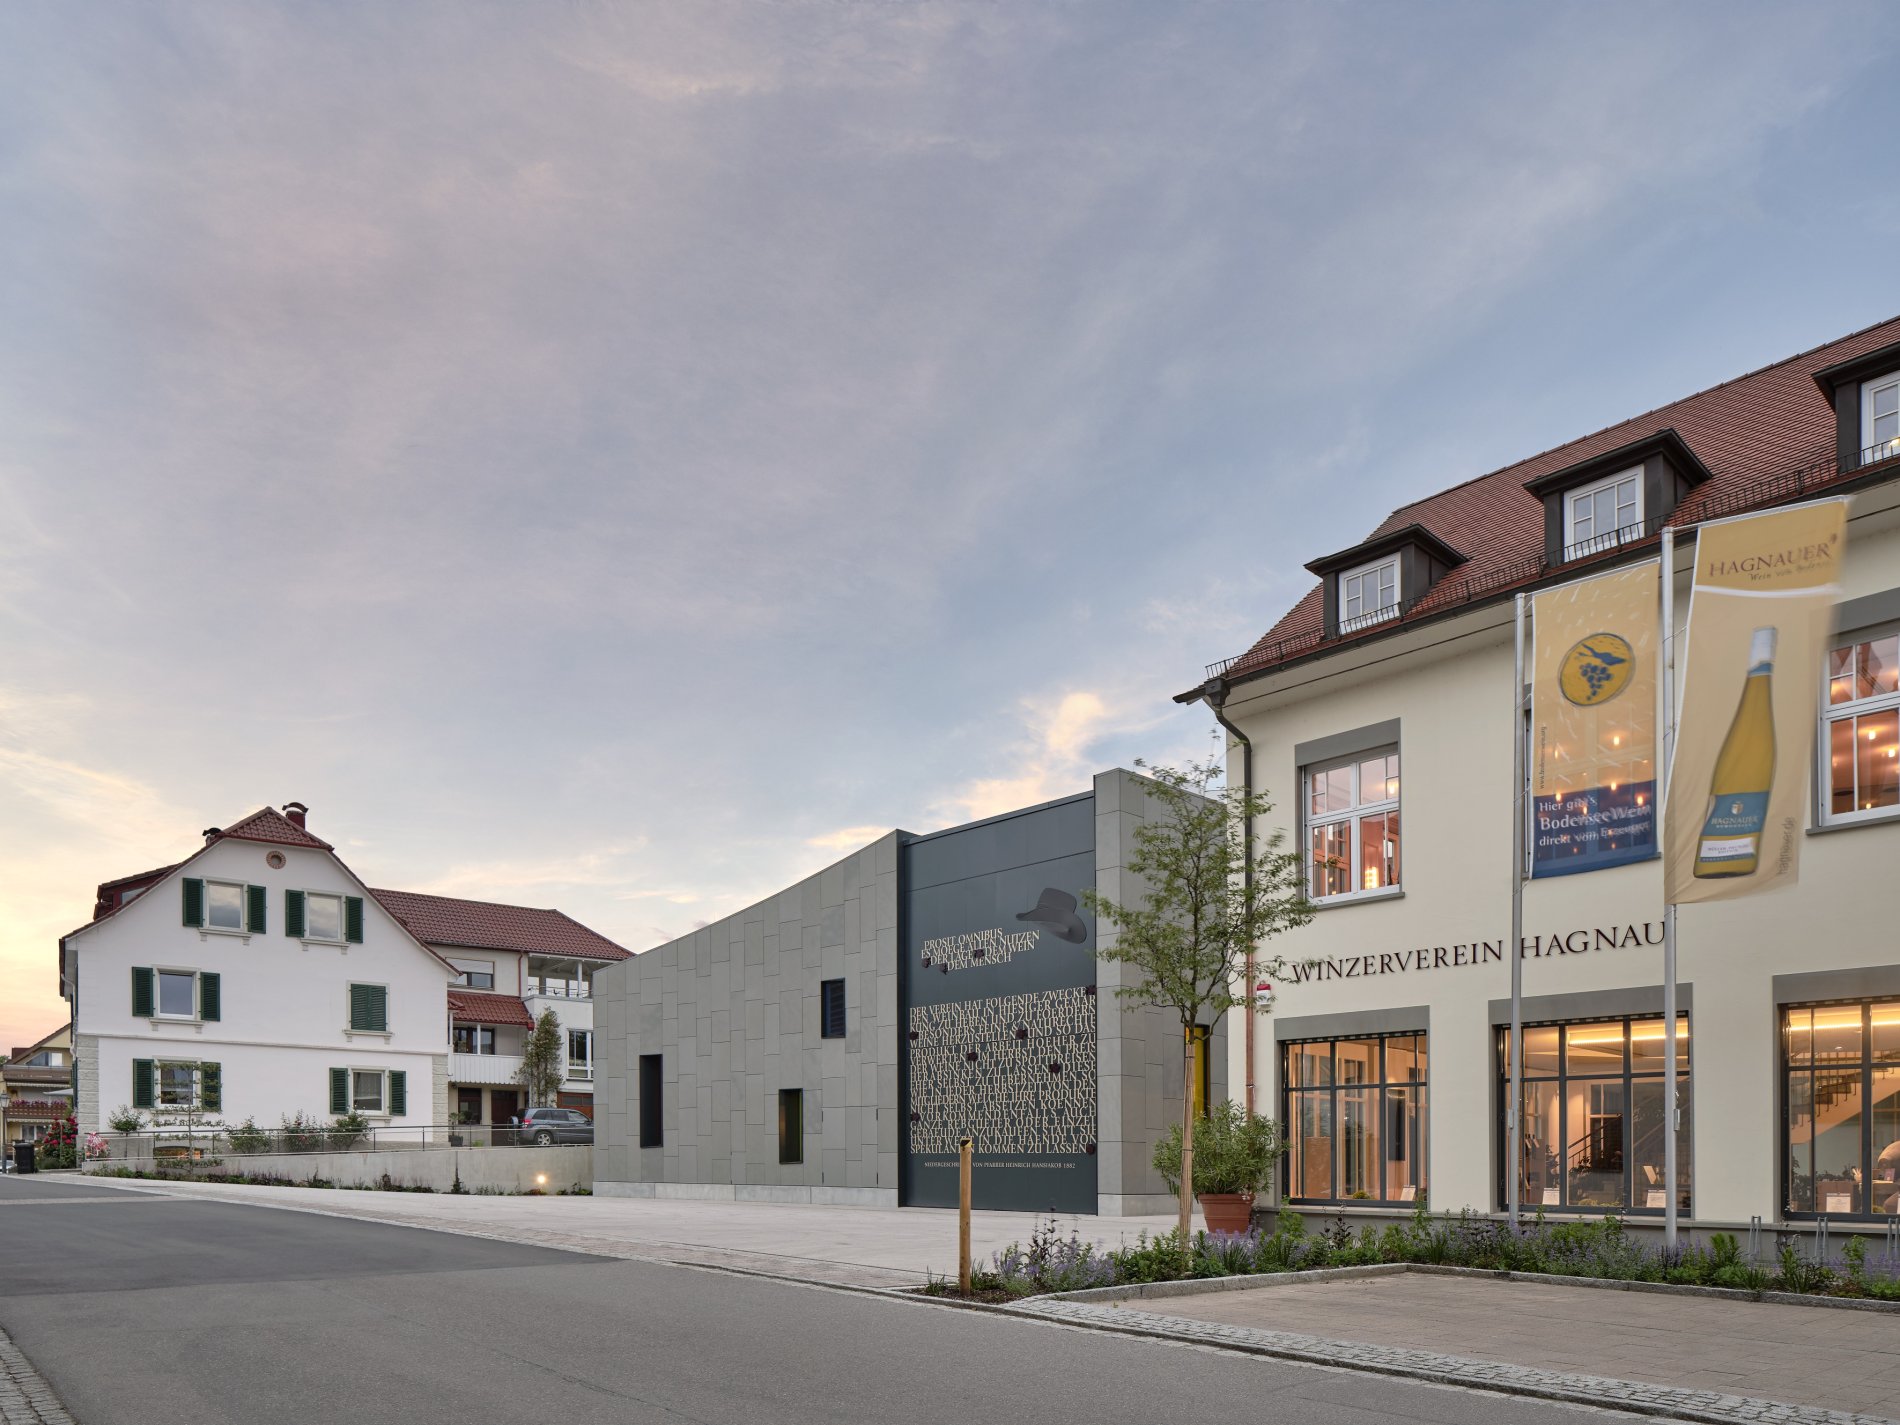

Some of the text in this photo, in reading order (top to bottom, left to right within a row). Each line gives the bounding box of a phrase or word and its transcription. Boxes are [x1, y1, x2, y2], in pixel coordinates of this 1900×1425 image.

[1709, 542, 1833, 577] HAGNAUER
[1539, 801, 1563, 812] Hier
[1540, 804, 1652, 831] BodenseeWein
[1539, 834, 1572, 847] direkt
[1574, 831, 1600, 843] vom
[921, 949, 931, 959] ES
[933, 942, 965, 957] MOEGE
[1000, 929, 1040, 946] NUTZEN
[924, 927, 1003, 951] PROSIT OMNIBUS
[930, 954, 948, 966] DER
[985, 945, 1004, 957] DEM
[1005, 939, 1035, 954] WEIN
[1291, 920, 1667, 983] WINZERVEREIN HAGNAU
[947, 951, 1012, 972] DEM MENSCH
[910, 987, 1087, 1017] DER VEREIN HAT FOLGENDE ZWECKE
[910, 1014, 928, 1025] DEN
[956, 1016, 987, 1028] HEBEN
[992, 1013, 1015, 1025] UND
[1017, 1011, 1033, 1022] ZU
[1037, 1005, 1095, 1020] FOERDERN
[910, 1038, 940, 1049] WEINE
[943, 1030, 1016, 1046] HERZUSTELLEN
[1028, 1027, 1053, 1039] UND
[1075, 1023, 1095, 1035] DAS
[919, 1026, 976, 1040] BESONDERS
[979, 1023, 1008, 1035] FEINE
[911, 1044, 957, 1057] PRODUKT
[961, 1042, 981, 1053] DER
[985, 1039, 1023, 1051] ARBEIT
[1027, 1034, 1076, 1048] HOEHER
[994, 1047, 1033, 1059] HERBST
[1038, 1044, 1061, 1056] DEN
[1067, 1042, 1095, 1054] PREIS
[911, 1063, 928, 1073] DER
[931, 1061, 961, 1072] WEINE
[964, 1058, 996, 1070] NICHT
[1016, 1051, 1095, 1066] SPOTTPREISEN
[911, 1068, 982, 1081] HERABSINKEN
[1008, 1063, 1049, 1075] LASSEN
[1063, 1060, 1095, 1072] DIESE
[911, 1079, 934, 1089] EHER
[937, 1077, 971, 1088] SELBST
[911, 1088, 928, 1097] WIE
[979, 1082, 1042, 1094] HERBSTZEIT
[1047, 1080, 1070, 1091] VON
[1074, 1079, 1096, 1090] DEN
[968, 1092, 1008, 1103] WELCHE
[1012, 1091, 1035, 1101] IHRE
[1039, 1088, 1096, 1100] PRODUKTE
[911, 1097, 1096, 1113] NICHT SELBST ABSETZEN KOENNEN
[1064, 1107, 1096, 1118] AUCH
[911, 1120, 943, 1130] GANZE
[1016, 1117, 1049, 1128] ODER
[965, 1126, 1038, 1137] ANZUKAUFEN
[1080, 1125, 1096, 1136] SIE
[978, 1144, 1025, 1154] KOMMEN
[1046, 1144, 1087, 1154] LASSEN
[995, 1136, 1014, 1145] DIE
[1019, 1135, 1068, 1145] HAENDE
[1072, 1135, 1096, 1145] VON
